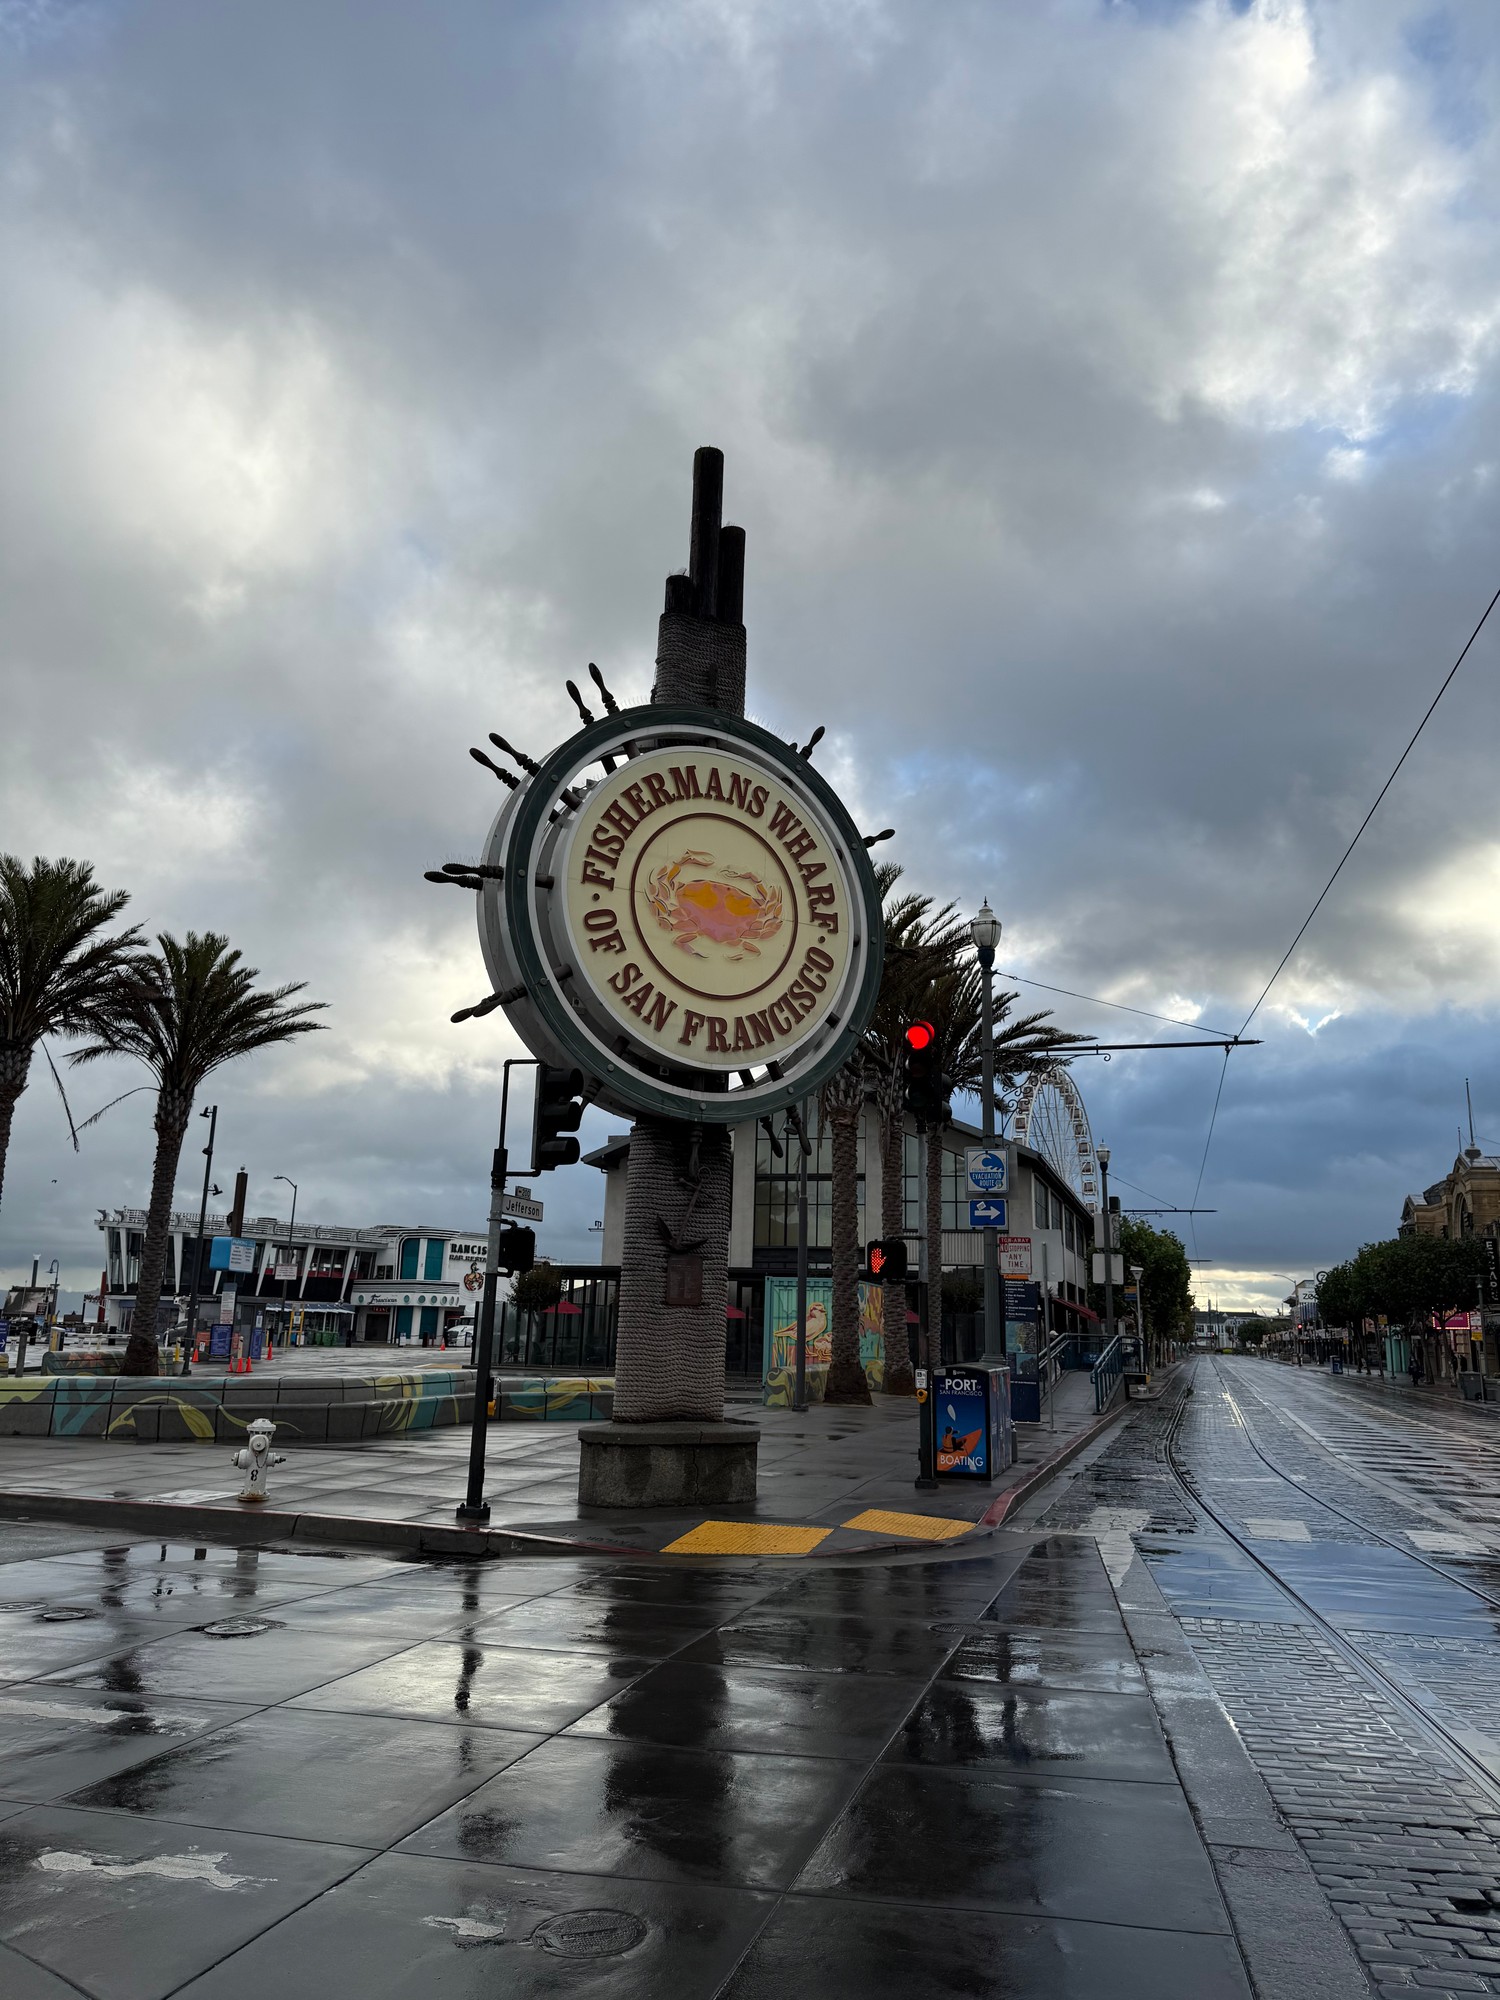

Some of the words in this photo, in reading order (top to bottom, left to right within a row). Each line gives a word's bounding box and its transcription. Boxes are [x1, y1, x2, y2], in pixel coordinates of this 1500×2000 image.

[581, 765, 770, 892] FISHERMANS
[768, 800, 839, 935] WHARF
[583, 908, 627, 955] OF
[607, 963, 678, 1033] SAN
[678, 946, 835, 1053] FRANCISCO
[505, 1200, 540, 1216] Jefferson
[450, 1243, 488, 1256] RANCIS
[1000, 1243, 1009, 1252] NO
[945, 1378, 978, 1391] PORT
[940, 1454, 984, 1467] BOATING
[251, 1469, 258, 1481] 8
